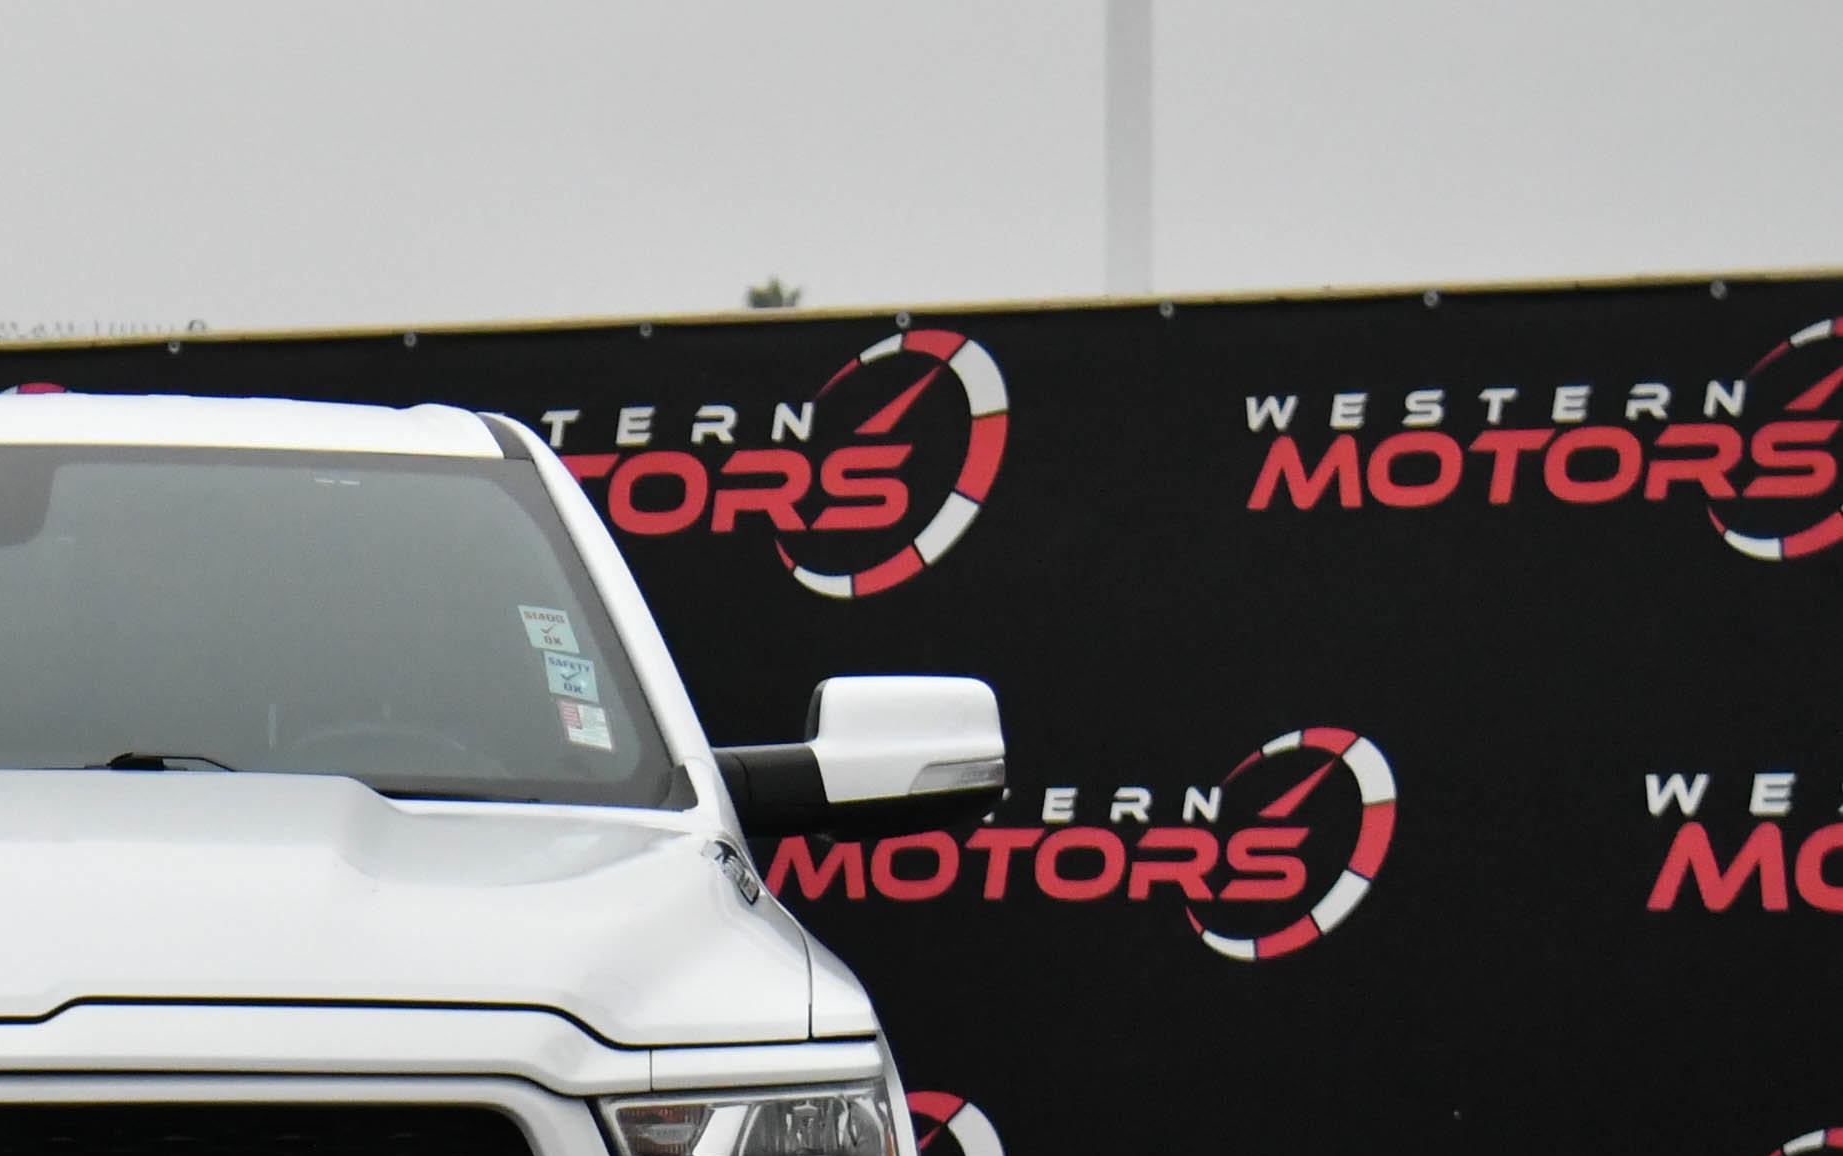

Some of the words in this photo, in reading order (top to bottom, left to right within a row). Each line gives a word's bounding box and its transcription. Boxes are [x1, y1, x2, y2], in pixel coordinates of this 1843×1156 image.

[1245, 380, 1745, 431] WESTERN
[1248, 420, 1841, 511] MOTORS
[765, 826, 1310, 902] MOTORS
